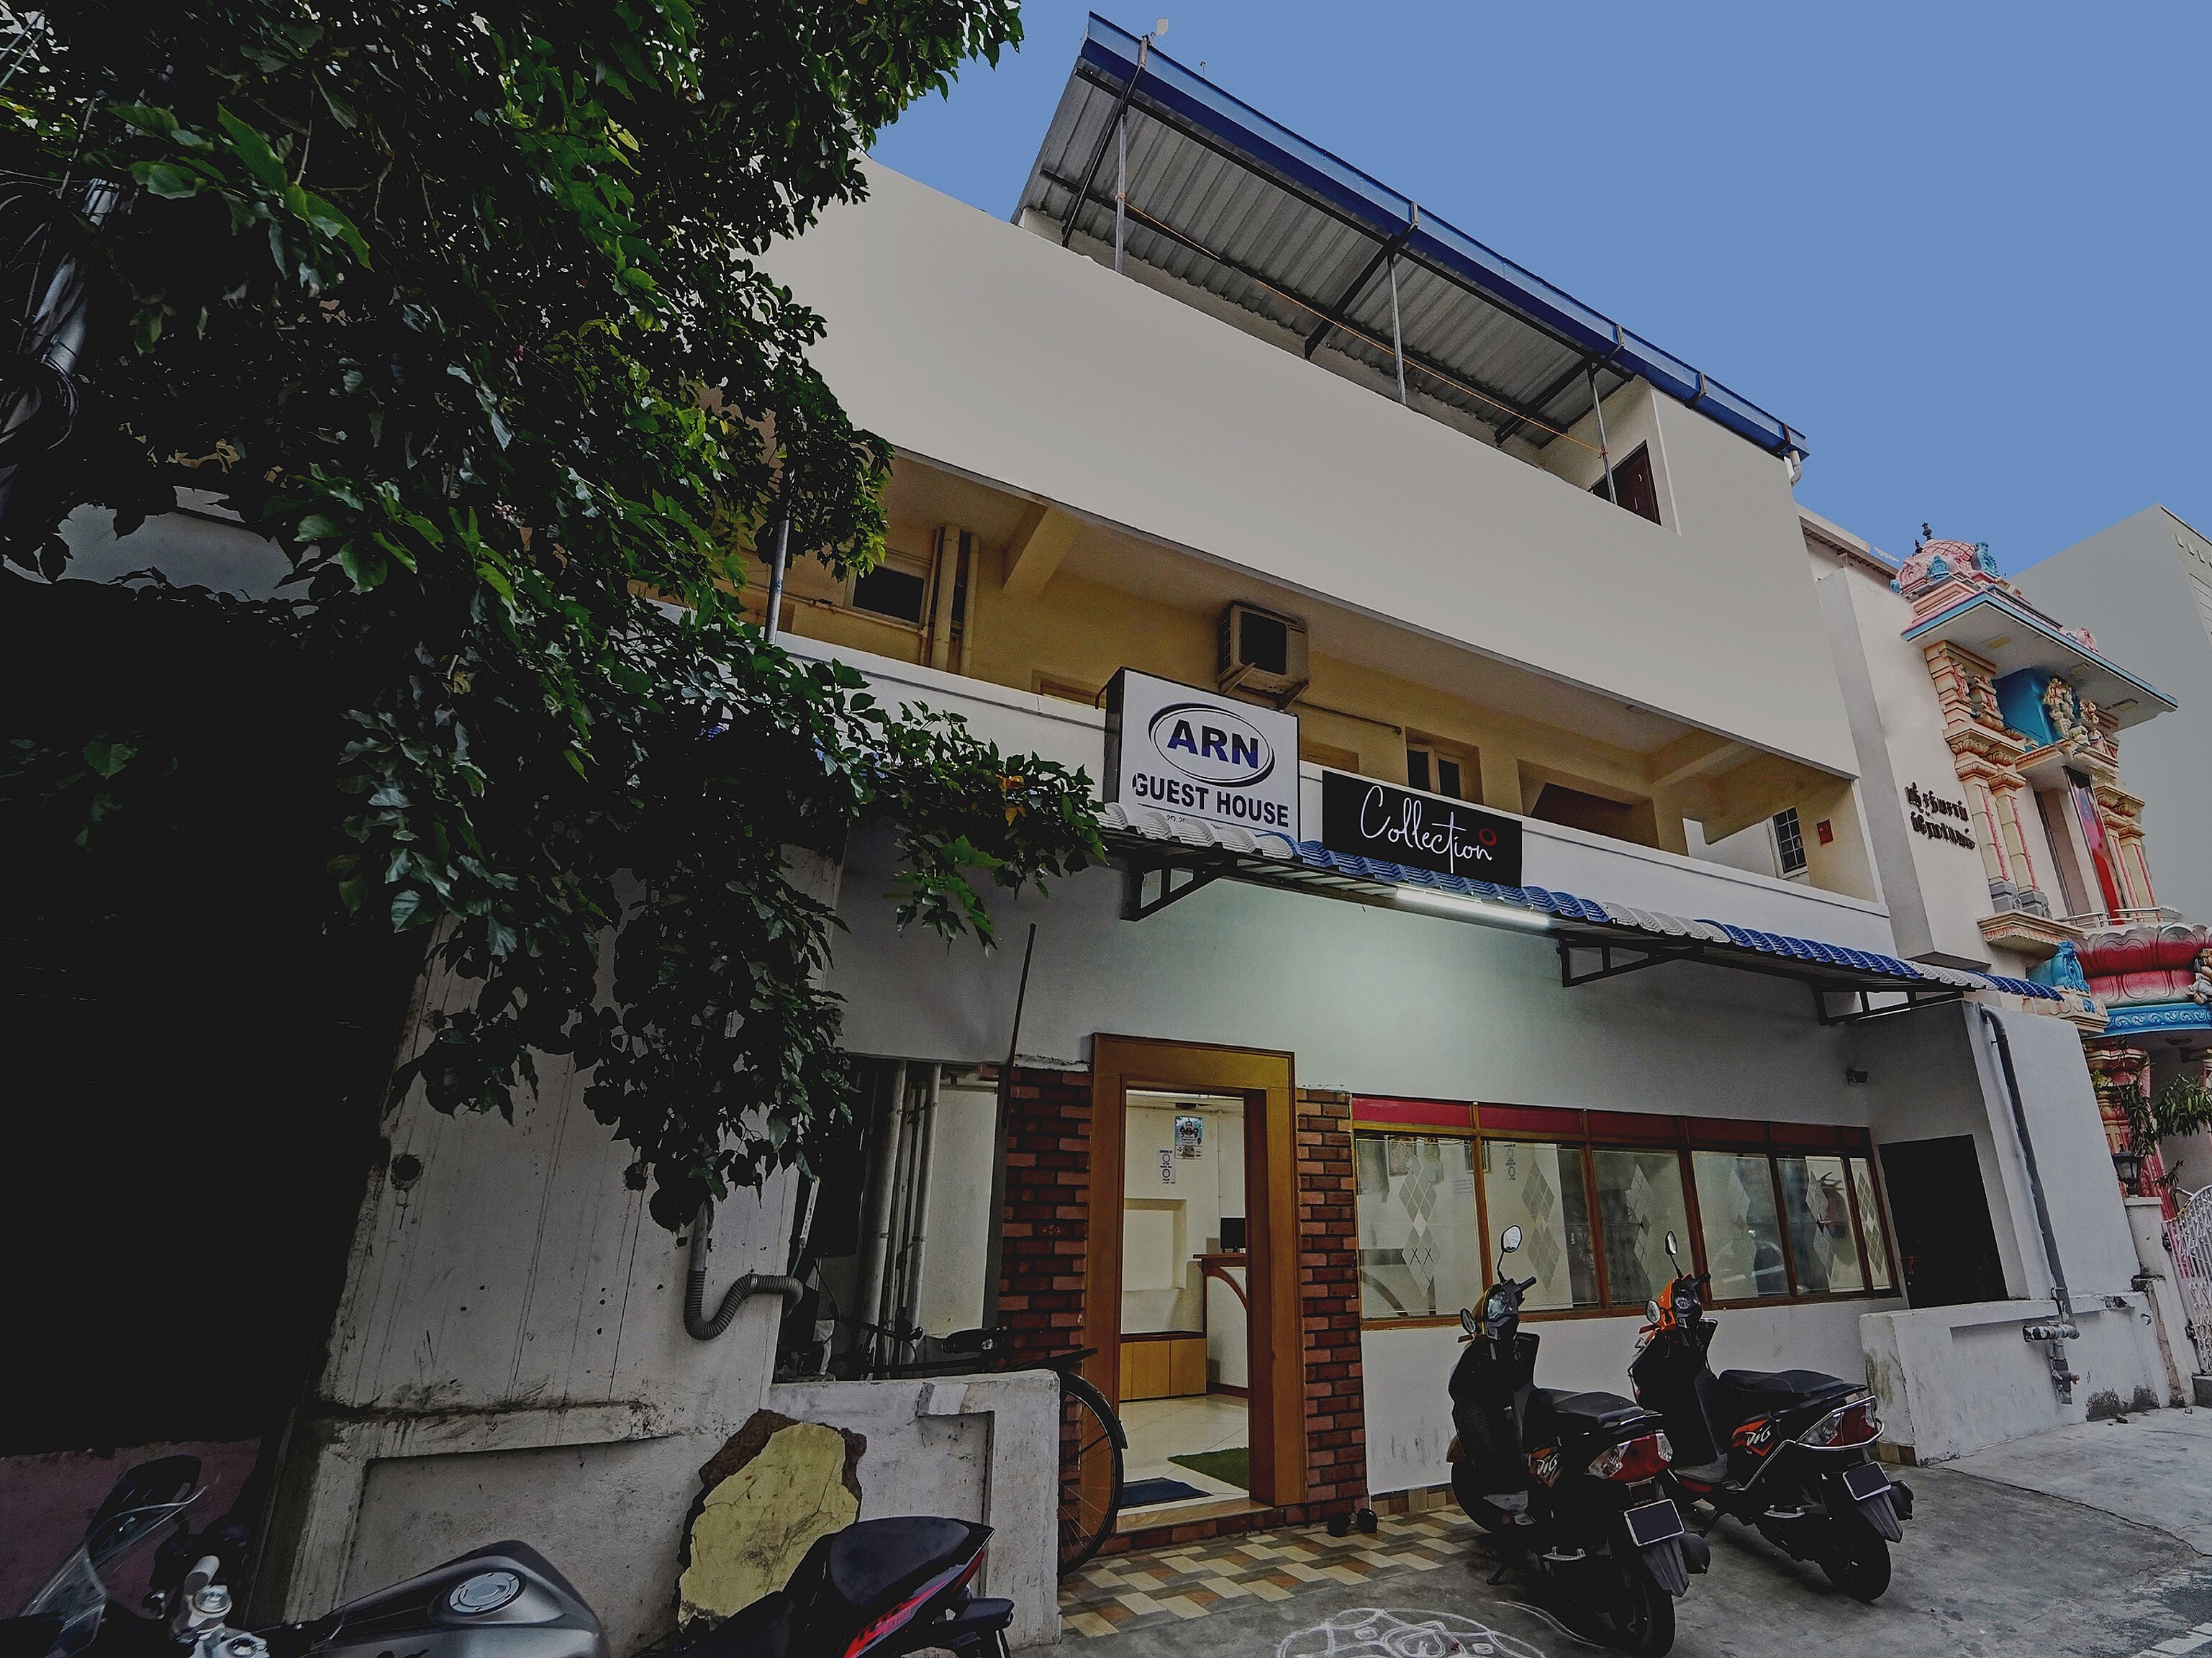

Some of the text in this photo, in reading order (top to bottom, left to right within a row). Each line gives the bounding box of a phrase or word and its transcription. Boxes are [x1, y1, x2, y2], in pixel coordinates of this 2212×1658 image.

[1166, 718, 1259, 769] ARN
[1132, 772, 1289, 828] GUEST HOUSE
[1359, 784, 1493, 874] Collection
